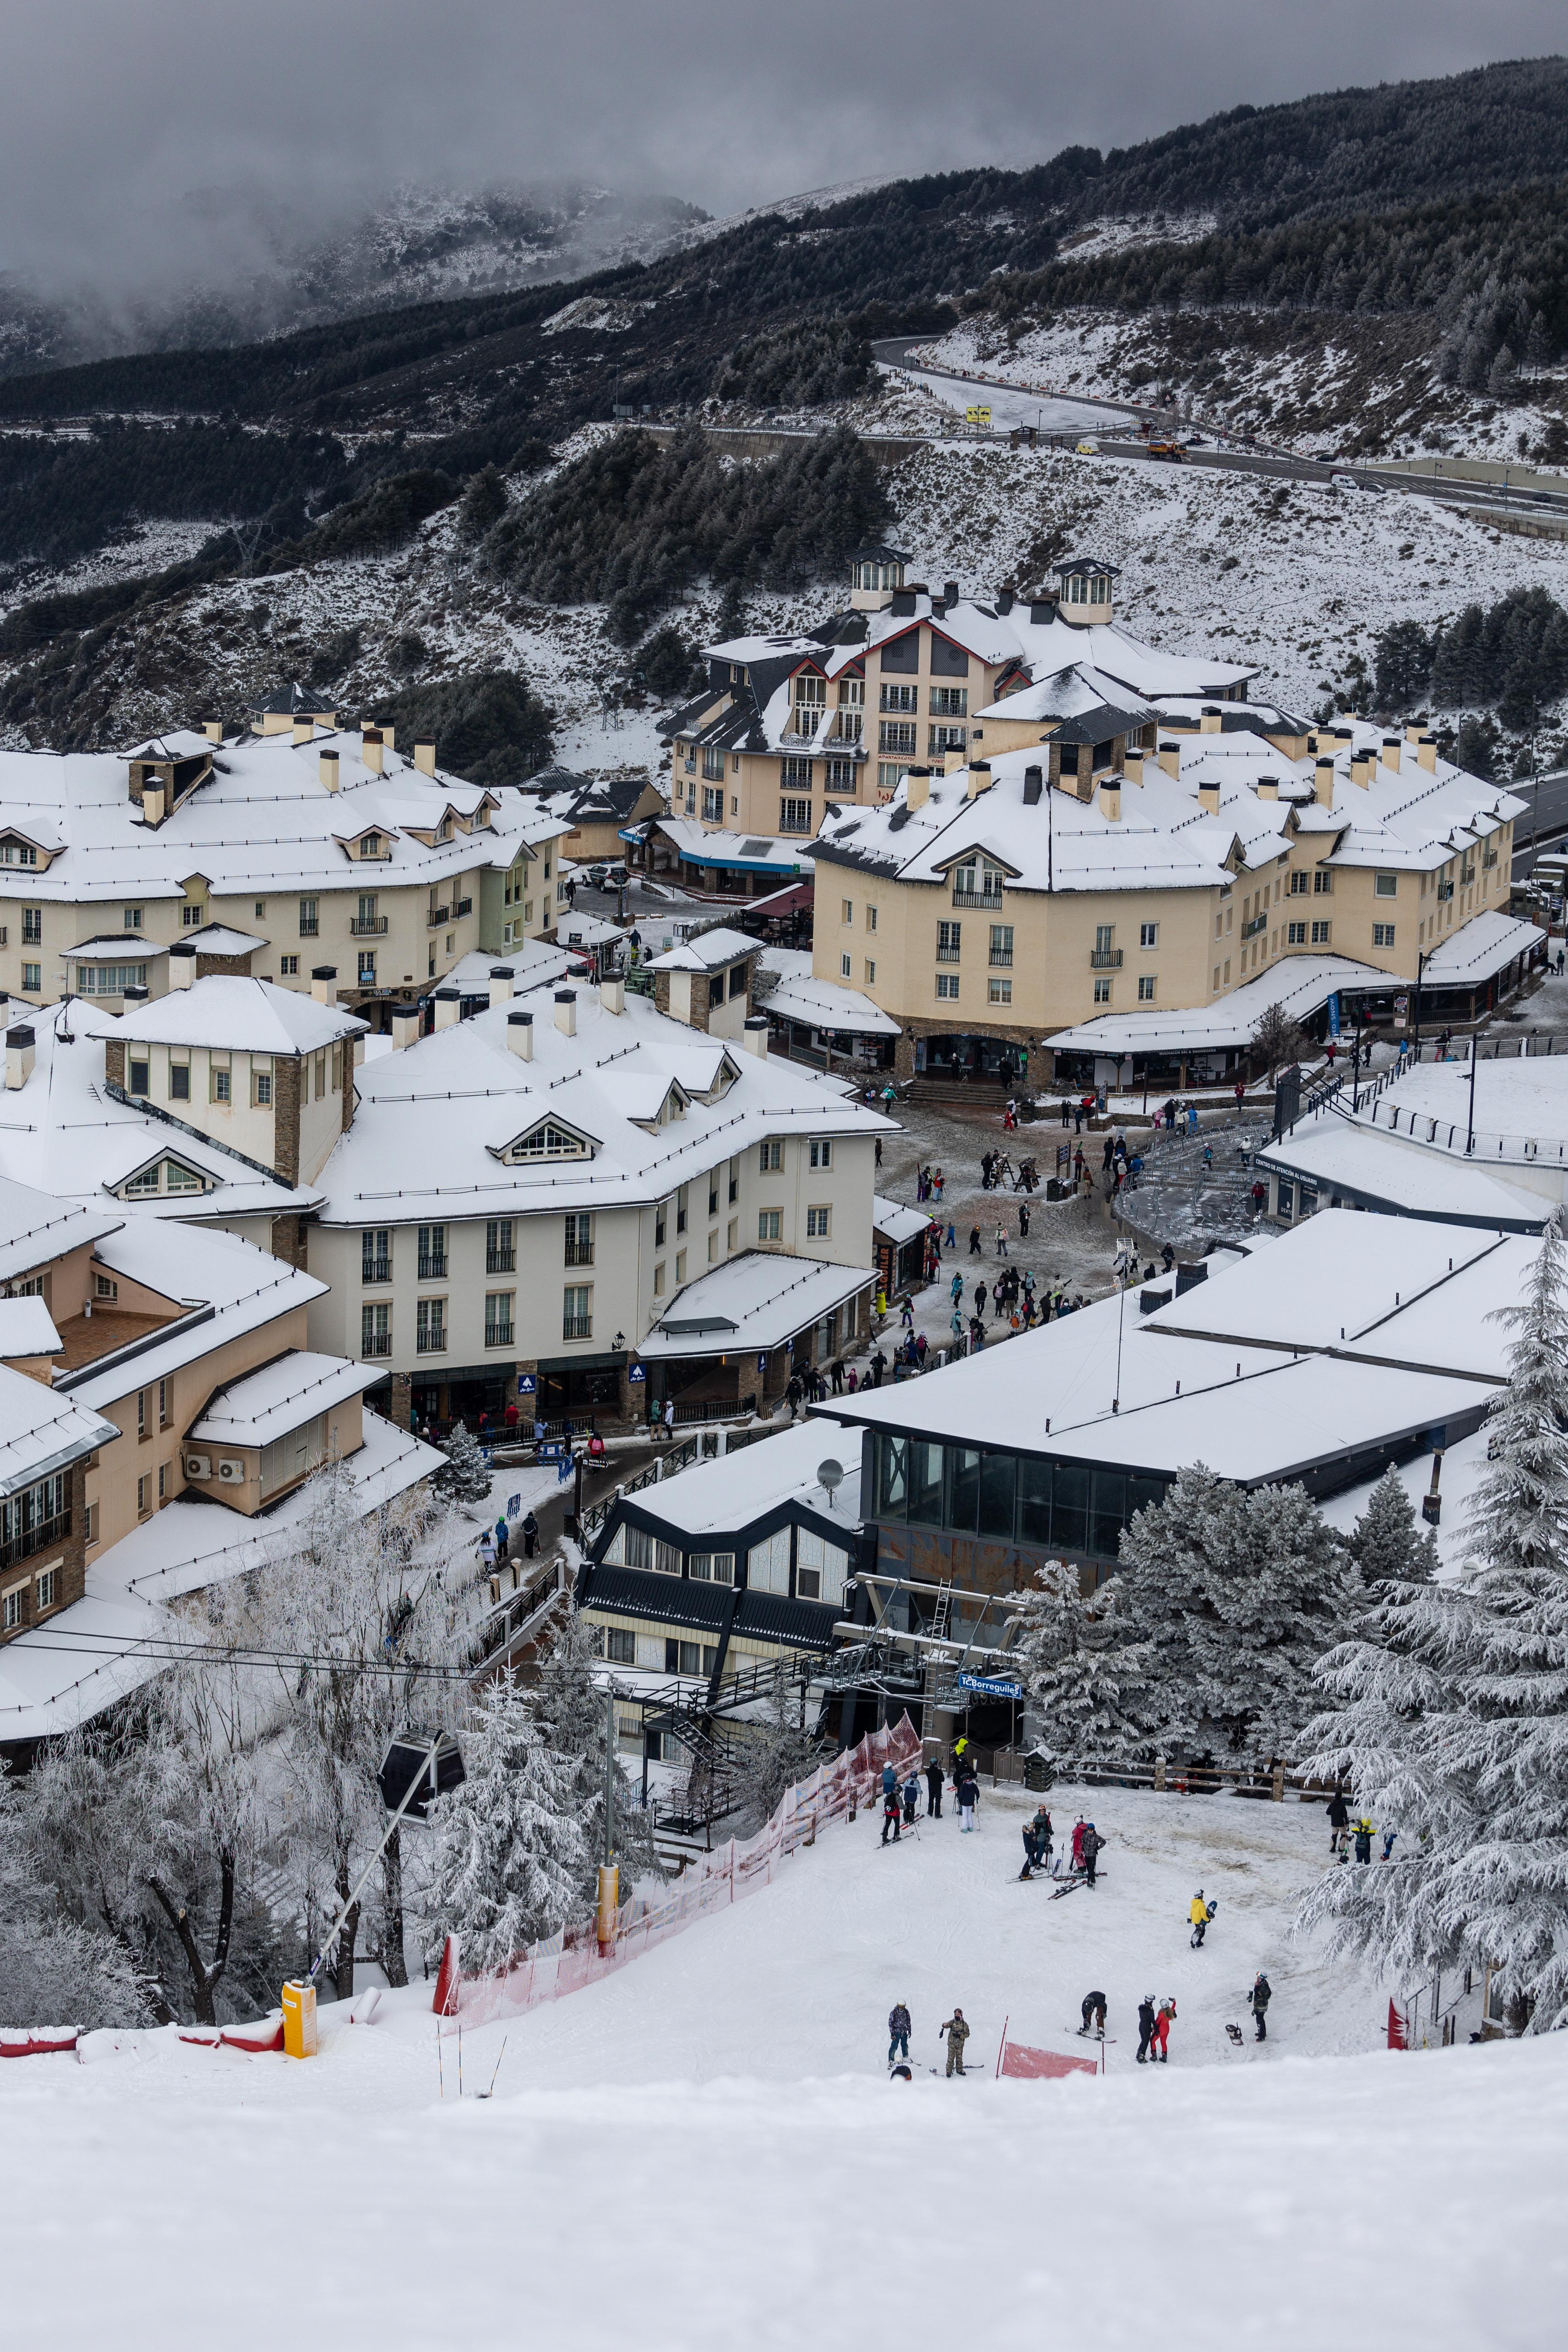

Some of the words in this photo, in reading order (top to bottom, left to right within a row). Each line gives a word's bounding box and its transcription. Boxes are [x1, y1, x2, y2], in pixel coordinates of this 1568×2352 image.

[1256, 1159, 1270, 1169] CENTRO
[1276, 1166, 1294, 1177] ATENCIÓN
[1300, 1175, 1317, 1186] USUARIO
[879, 1248, 889, 1295] LQUILER
